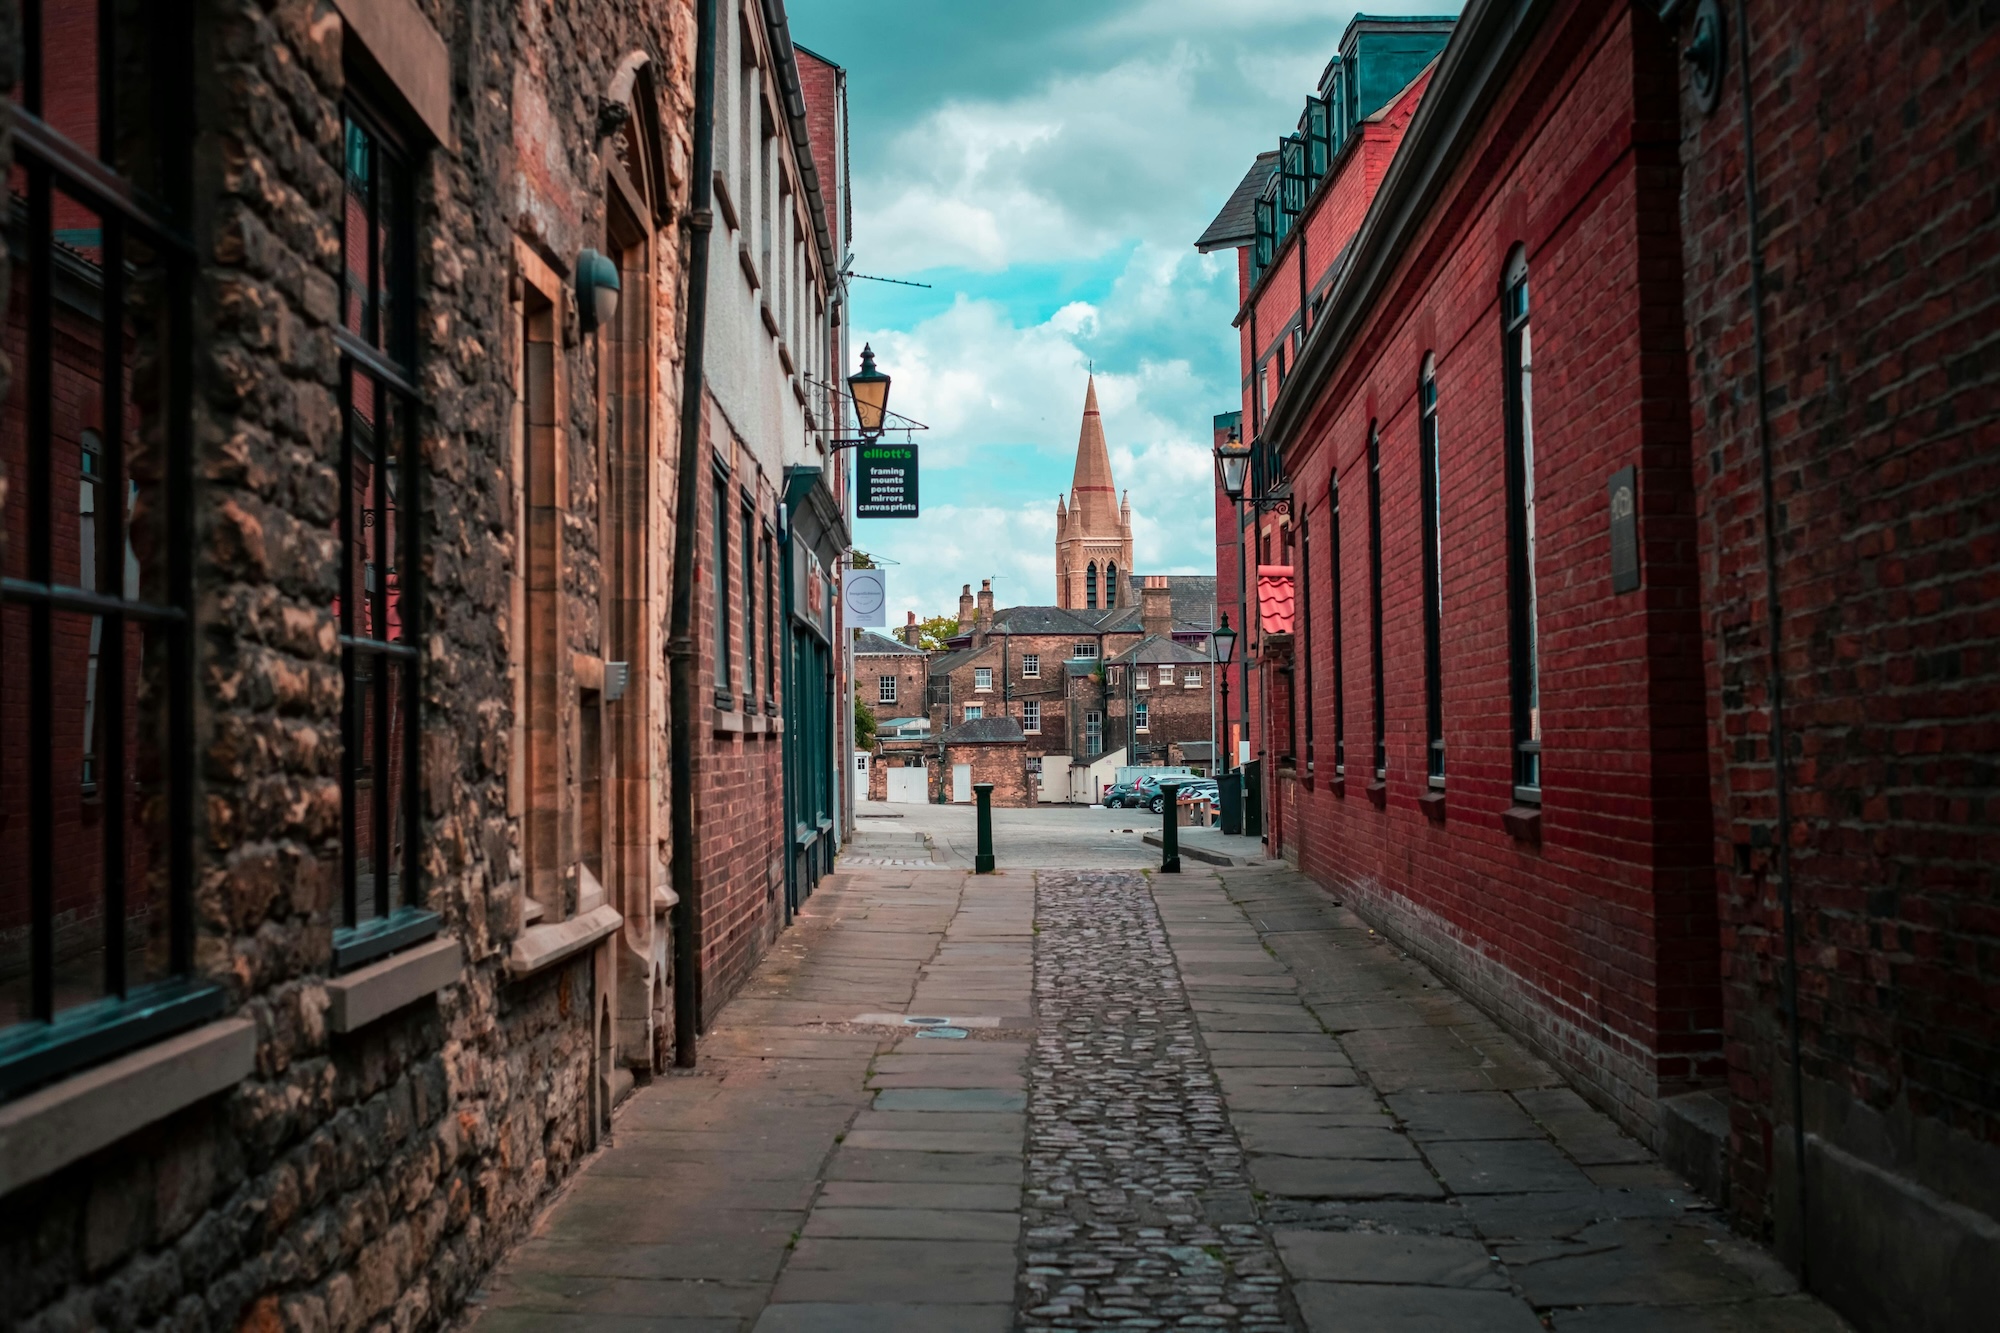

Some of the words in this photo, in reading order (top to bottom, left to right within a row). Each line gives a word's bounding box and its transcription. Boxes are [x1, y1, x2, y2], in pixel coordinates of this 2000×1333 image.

[864, 449, 911, 458] elliott's
[870, 467, 905, 476] framing
[871, 486, 904, 494] posters
[891, 503, 916, 512] prints
